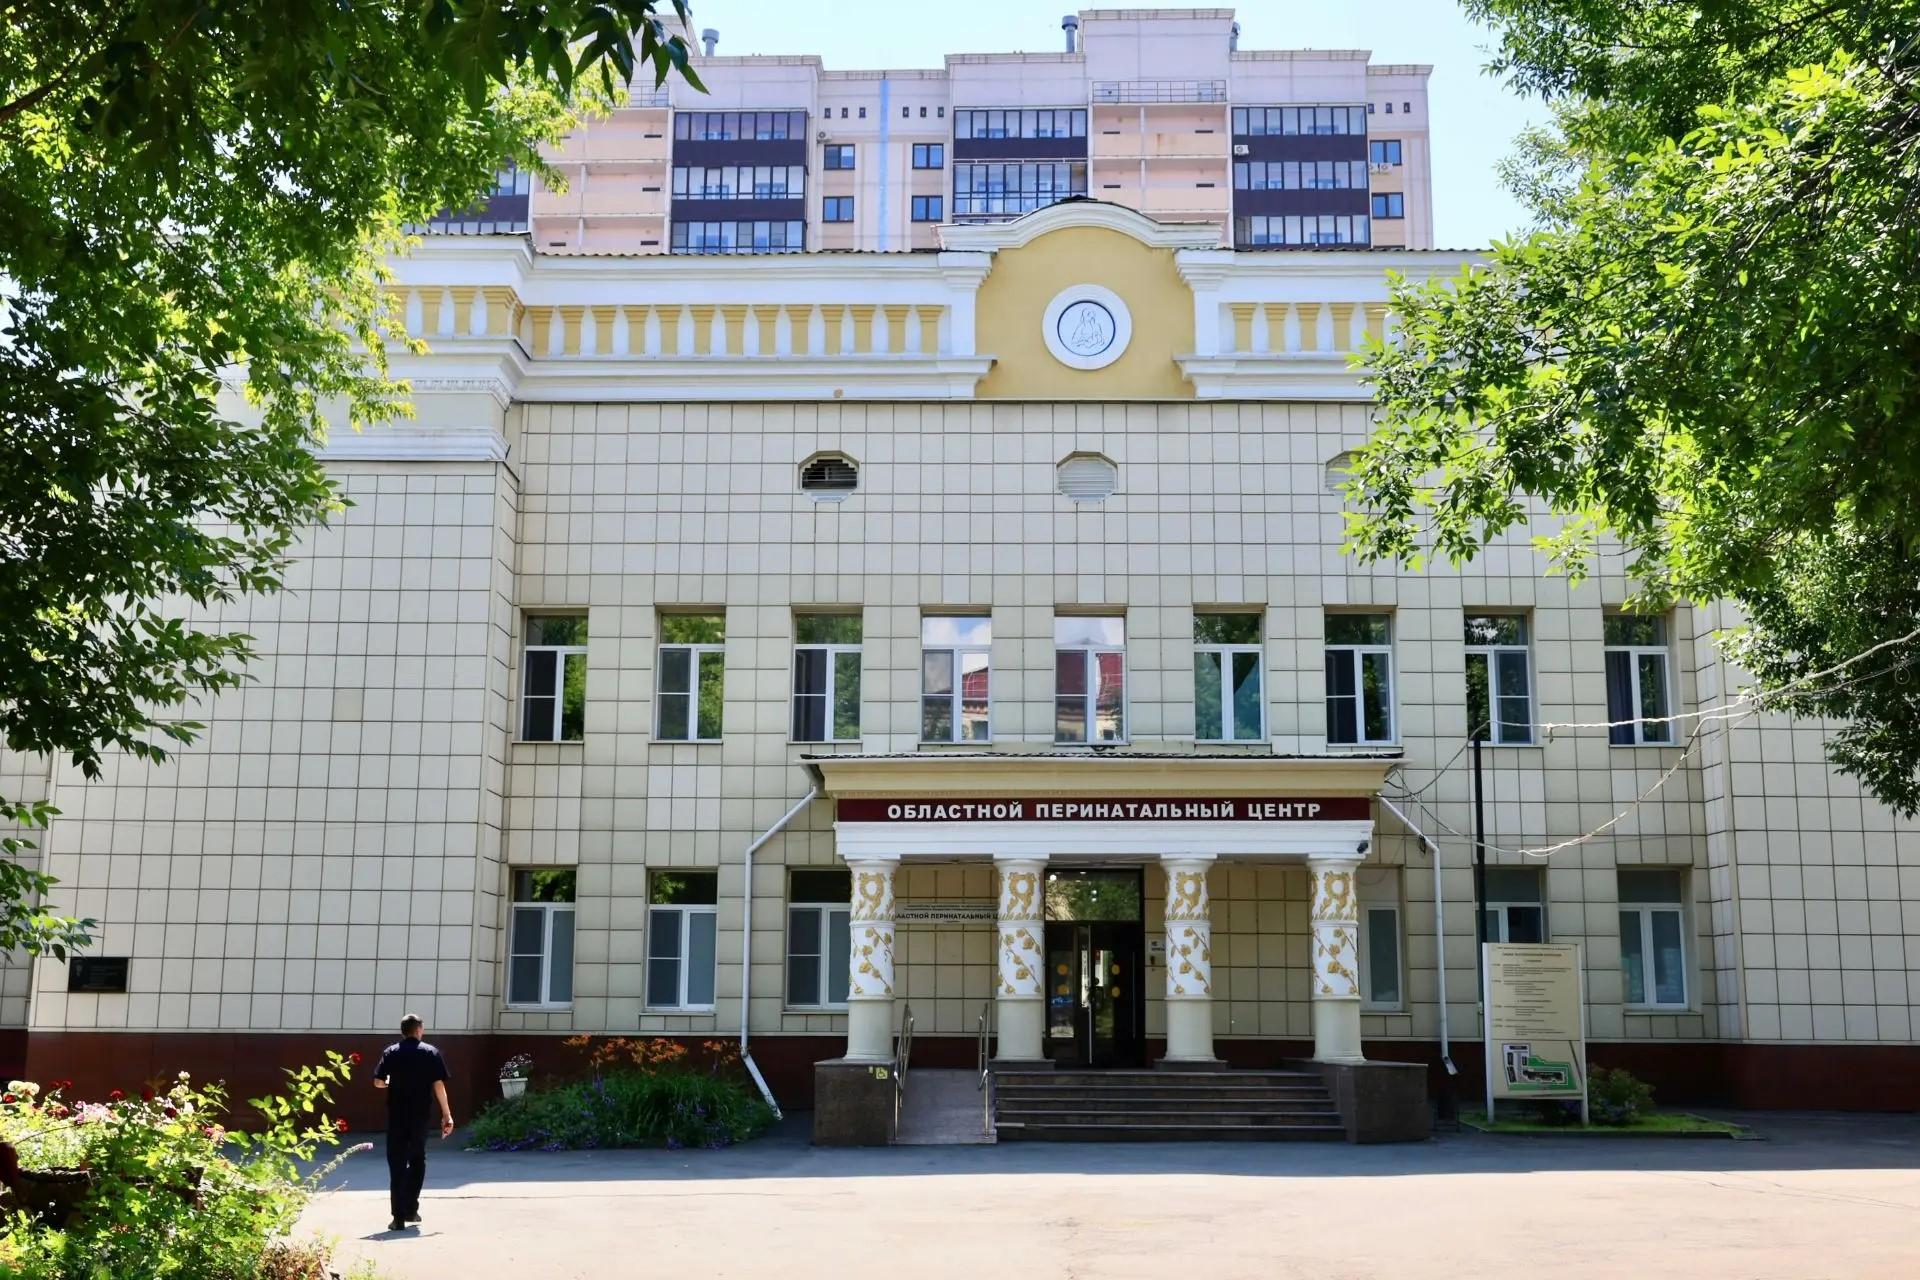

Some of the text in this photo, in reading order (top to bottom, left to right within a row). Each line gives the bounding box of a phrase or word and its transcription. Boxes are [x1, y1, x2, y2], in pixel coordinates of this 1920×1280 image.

[887, 801, 1321, 820] ОБЛАСТНОЙ ПЕРИНАТАЛЬНЫЙ ЦЕНТР
[896, 911, 929, 919] ЛАСТНОЙ
[930, 911, 991, 919] ПЕРИНАТАЛЬНЫЙ
